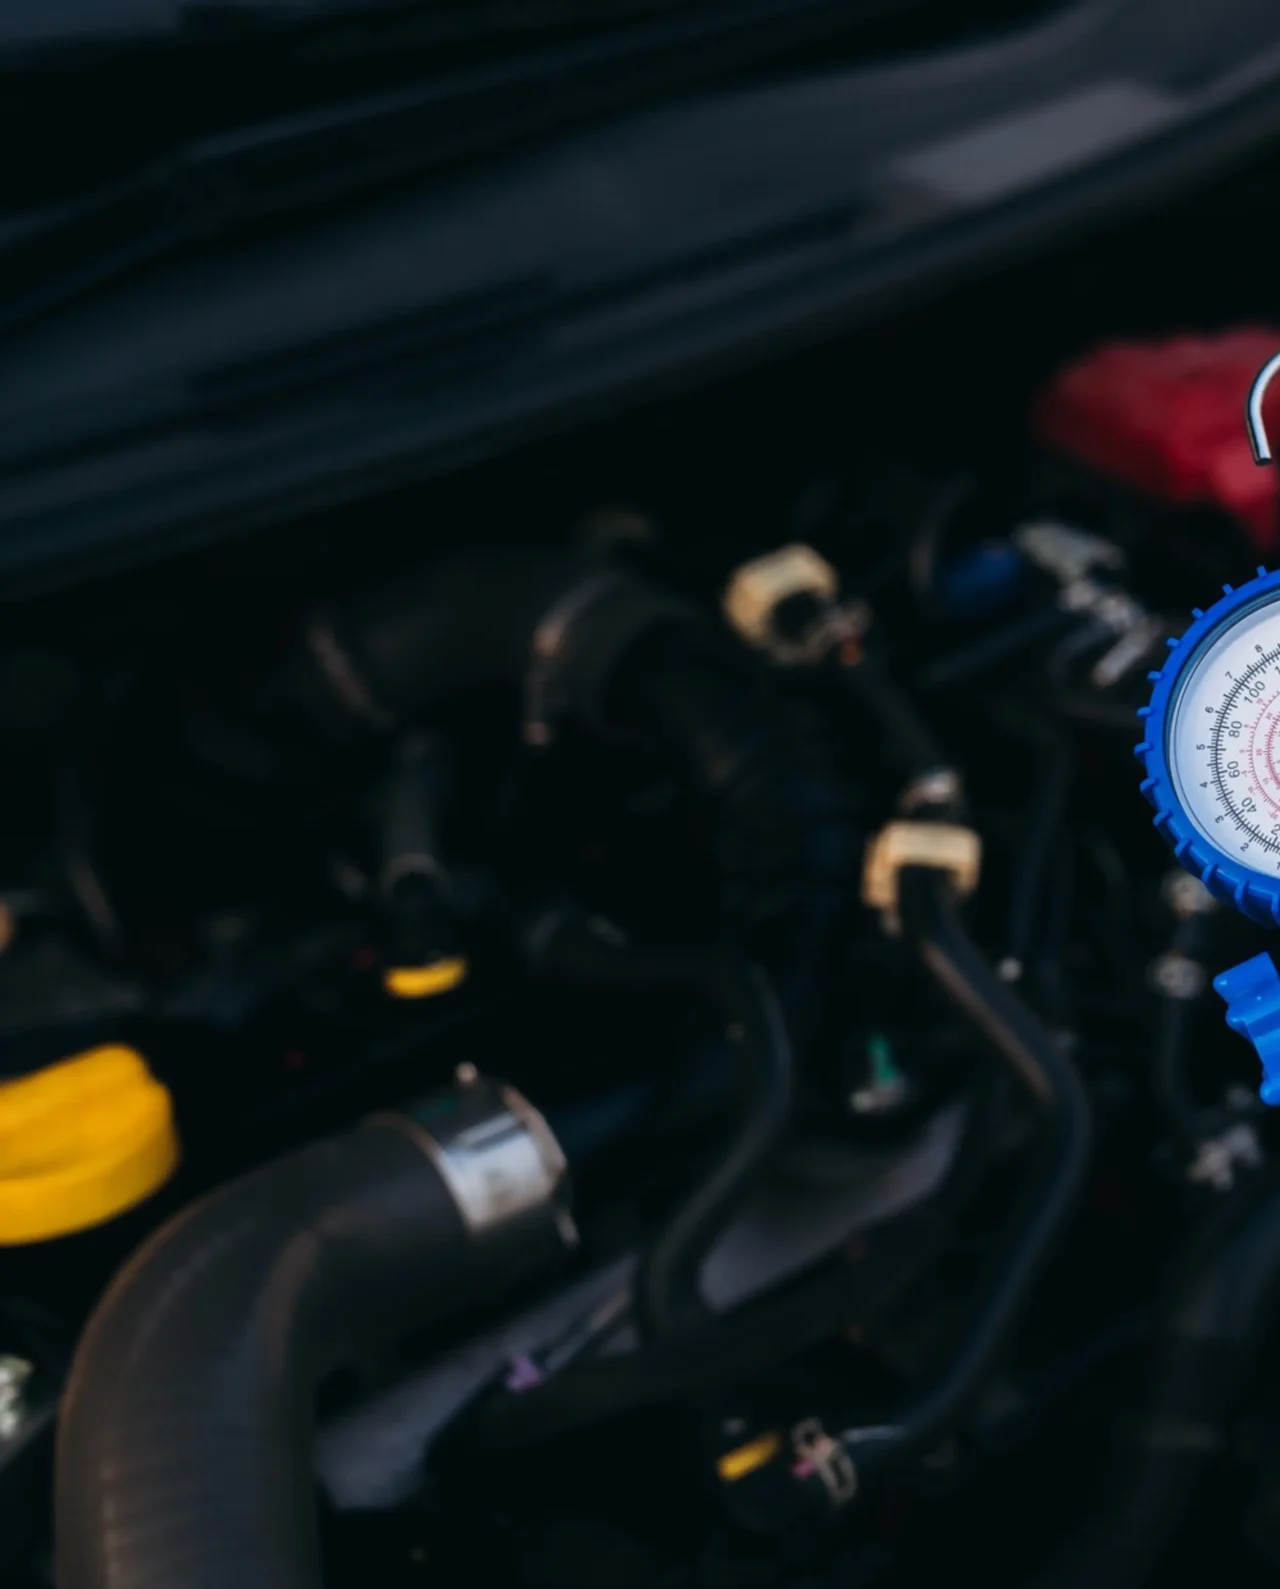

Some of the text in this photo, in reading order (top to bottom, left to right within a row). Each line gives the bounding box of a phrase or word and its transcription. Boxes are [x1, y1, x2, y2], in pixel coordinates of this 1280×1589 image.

[1225, 671, 1233, 679] 7
[1244, 681, 1265, 704] 100
[1228, 720, 1242, 738] 80
[1227, 761, 1240, 778] 60
[1241, 797, 1257, 814] 40
[1215, 815, 1224, 823] 3
[1240, 842, 1249, 852] 2
